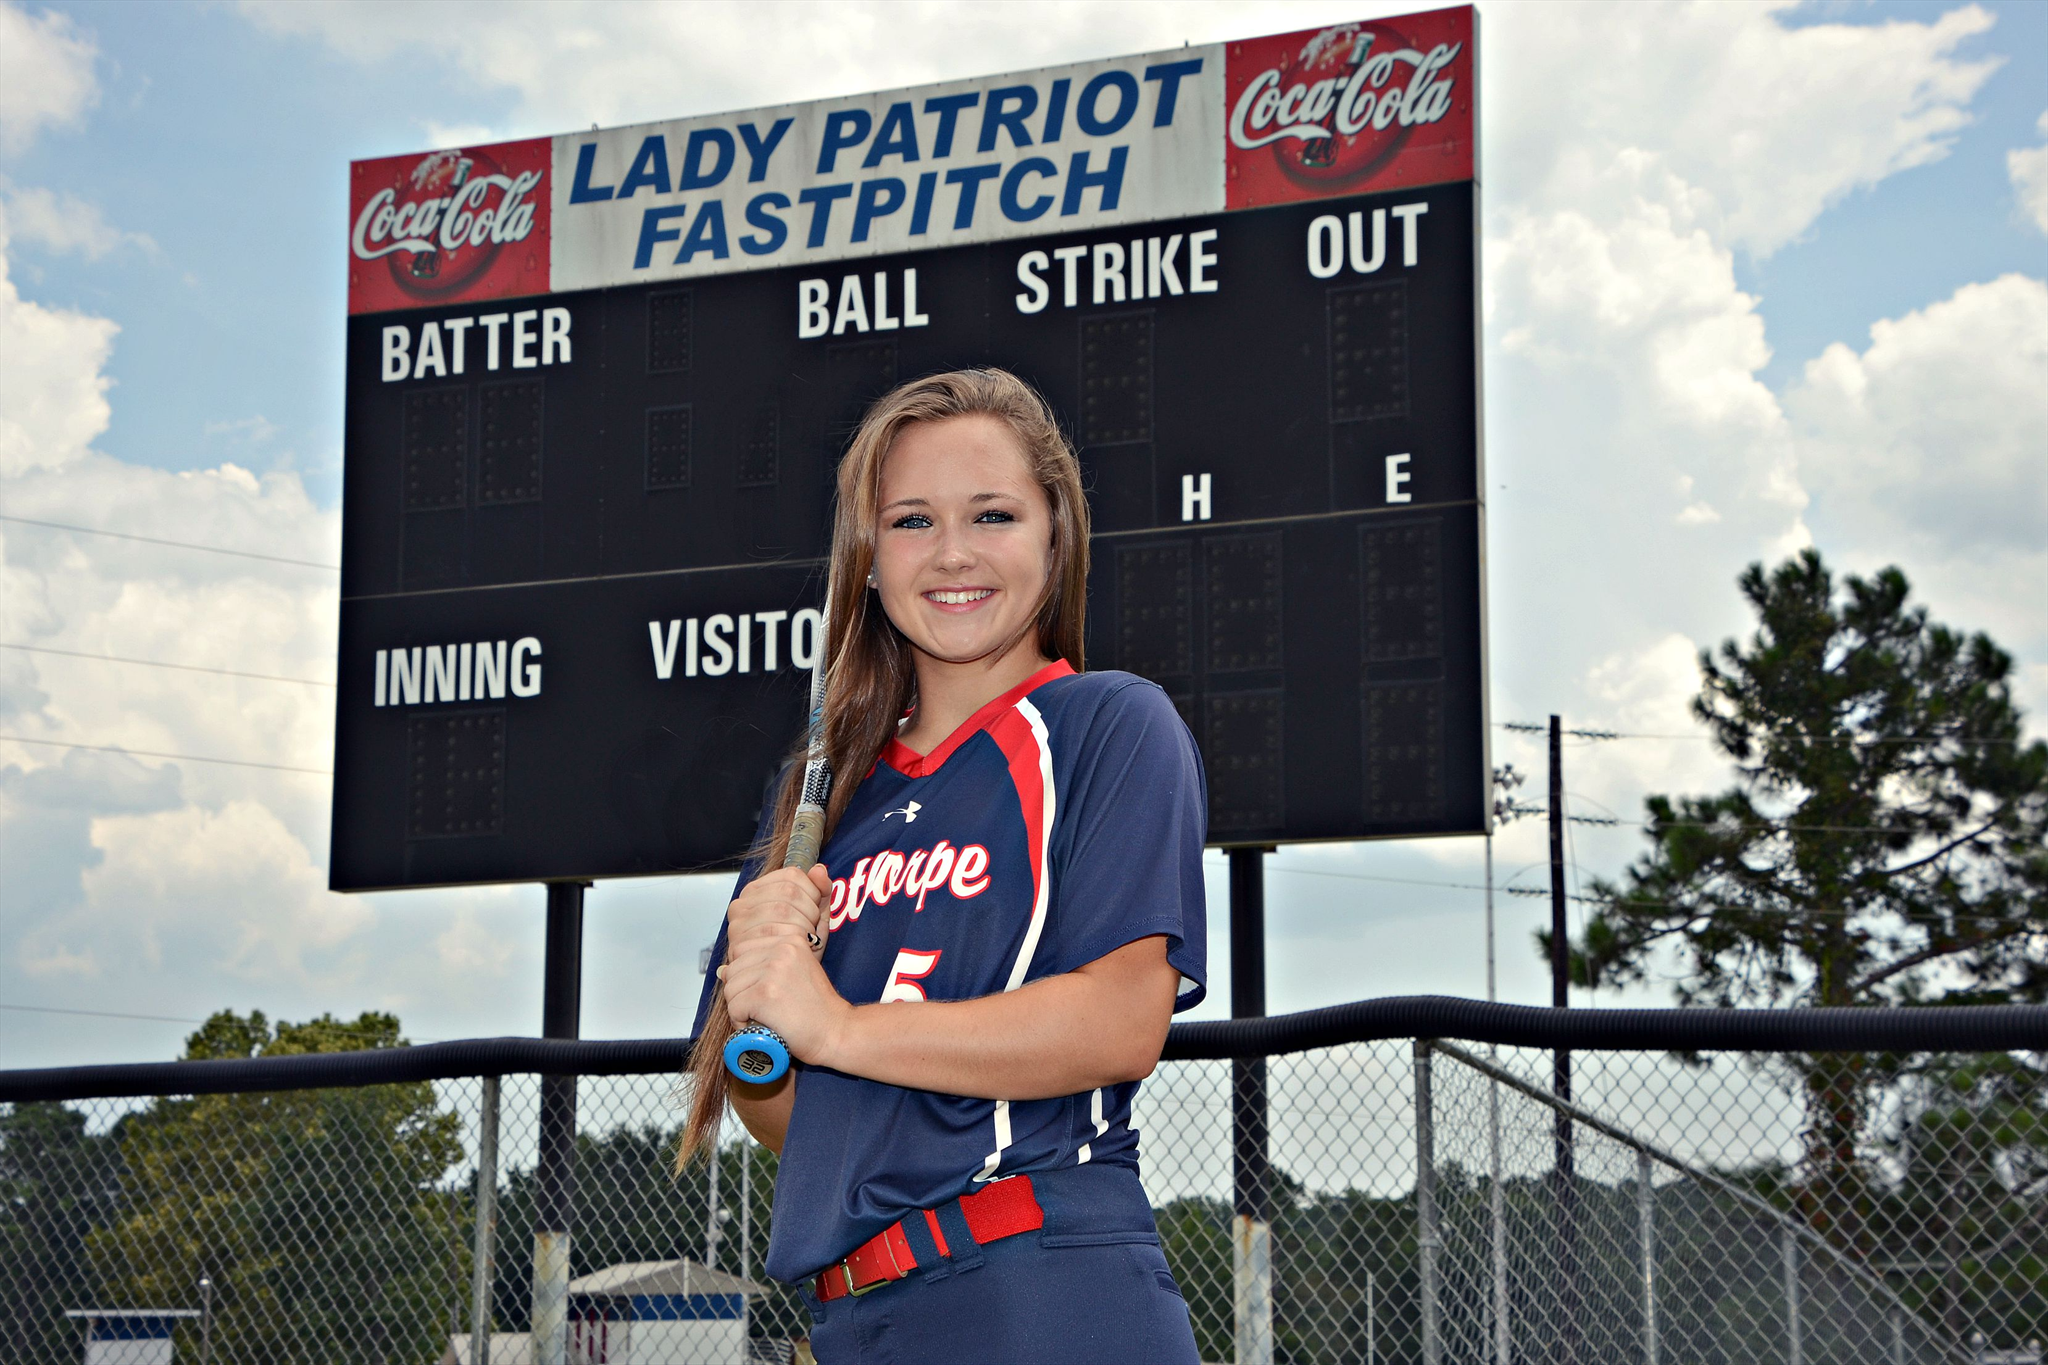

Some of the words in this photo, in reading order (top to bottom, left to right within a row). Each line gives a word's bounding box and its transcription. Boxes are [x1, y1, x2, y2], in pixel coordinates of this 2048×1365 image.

[569, 117, 795, 205] LADY
[817, 58, 1204, 174] PATRIOT
[1229, 41, 1462, 149] Coca-Cola
[352, 169, 543, 260] Coca-Cola
[633, 145, 1129, 269] FASTPITCH
[1307, 202, 1429, 278] OUT
[798, 267, 929, 339] BALL
[1015, 228, 1219, 314] STRIKE
[381, 307, 572, 382] BATTER
[1181, 473, 1212, 522] H
[1385, 452, 1412, 503] E
[374, 636, 542, 707] INNING
[879, 948, 942, 1003] 5
[740, 1057, 765, 1075] 32
